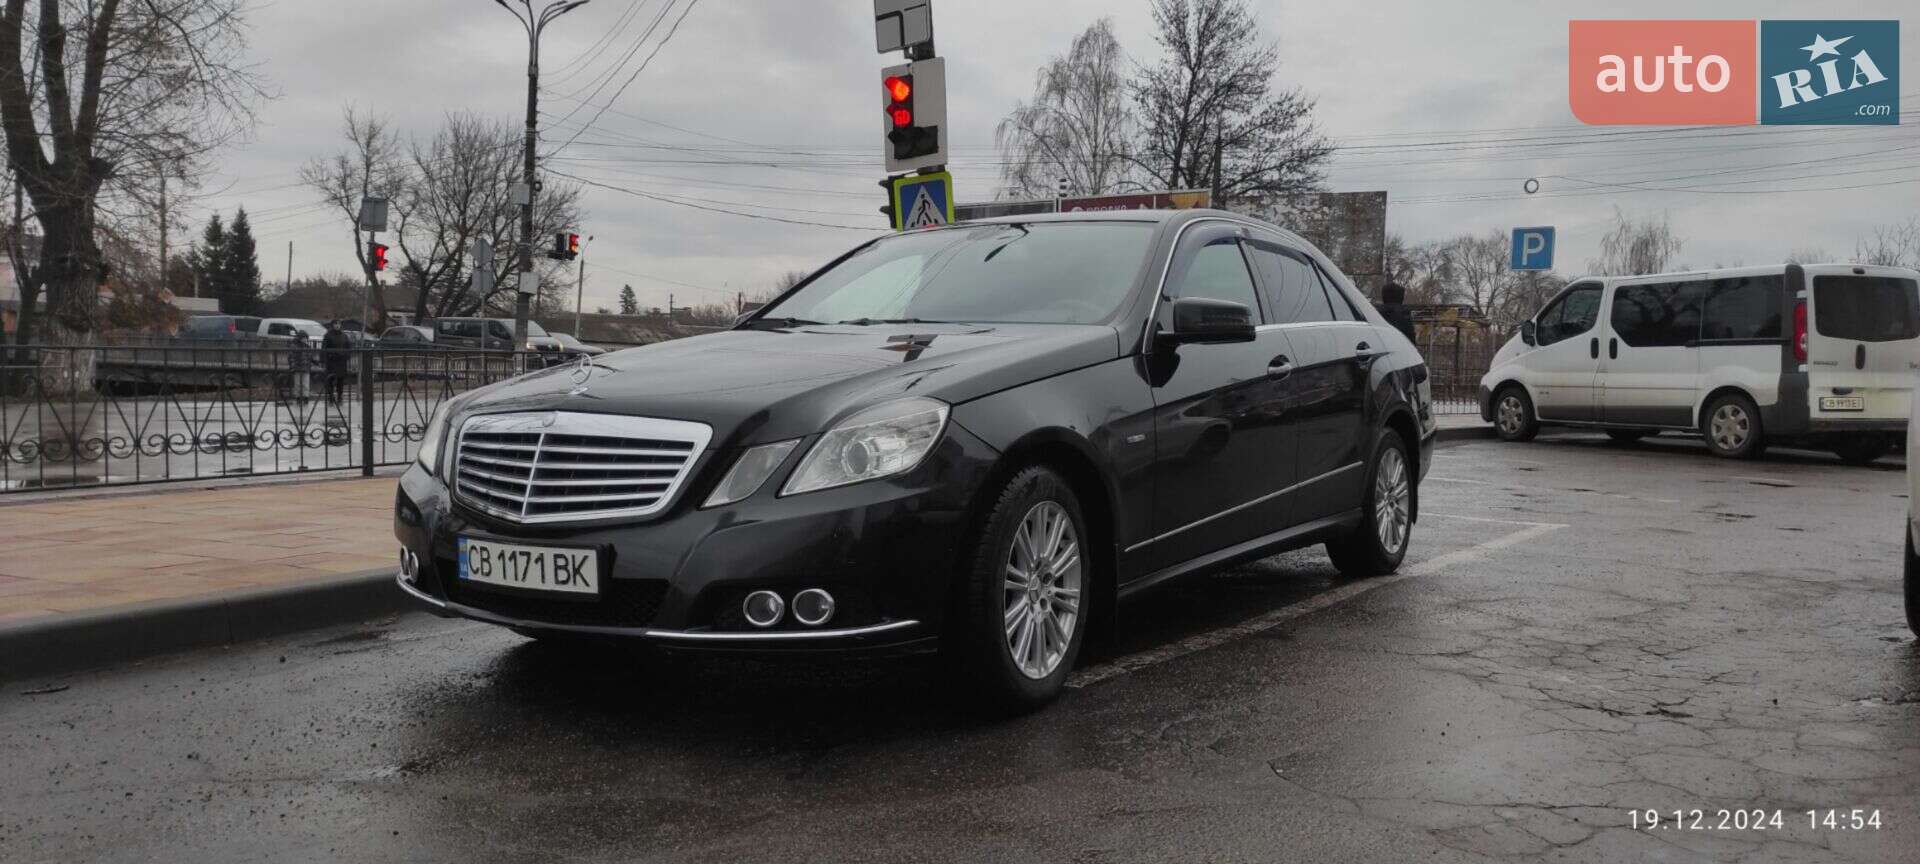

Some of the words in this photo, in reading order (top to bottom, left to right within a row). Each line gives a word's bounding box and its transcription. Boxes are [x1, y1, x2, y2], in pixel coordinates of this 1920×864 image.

[1522, 232, 1545, 266] P
[468, 544, 492, 577] CB
[498, 549, 545, 584] 1171
[553, 553, 590, 587] BK
